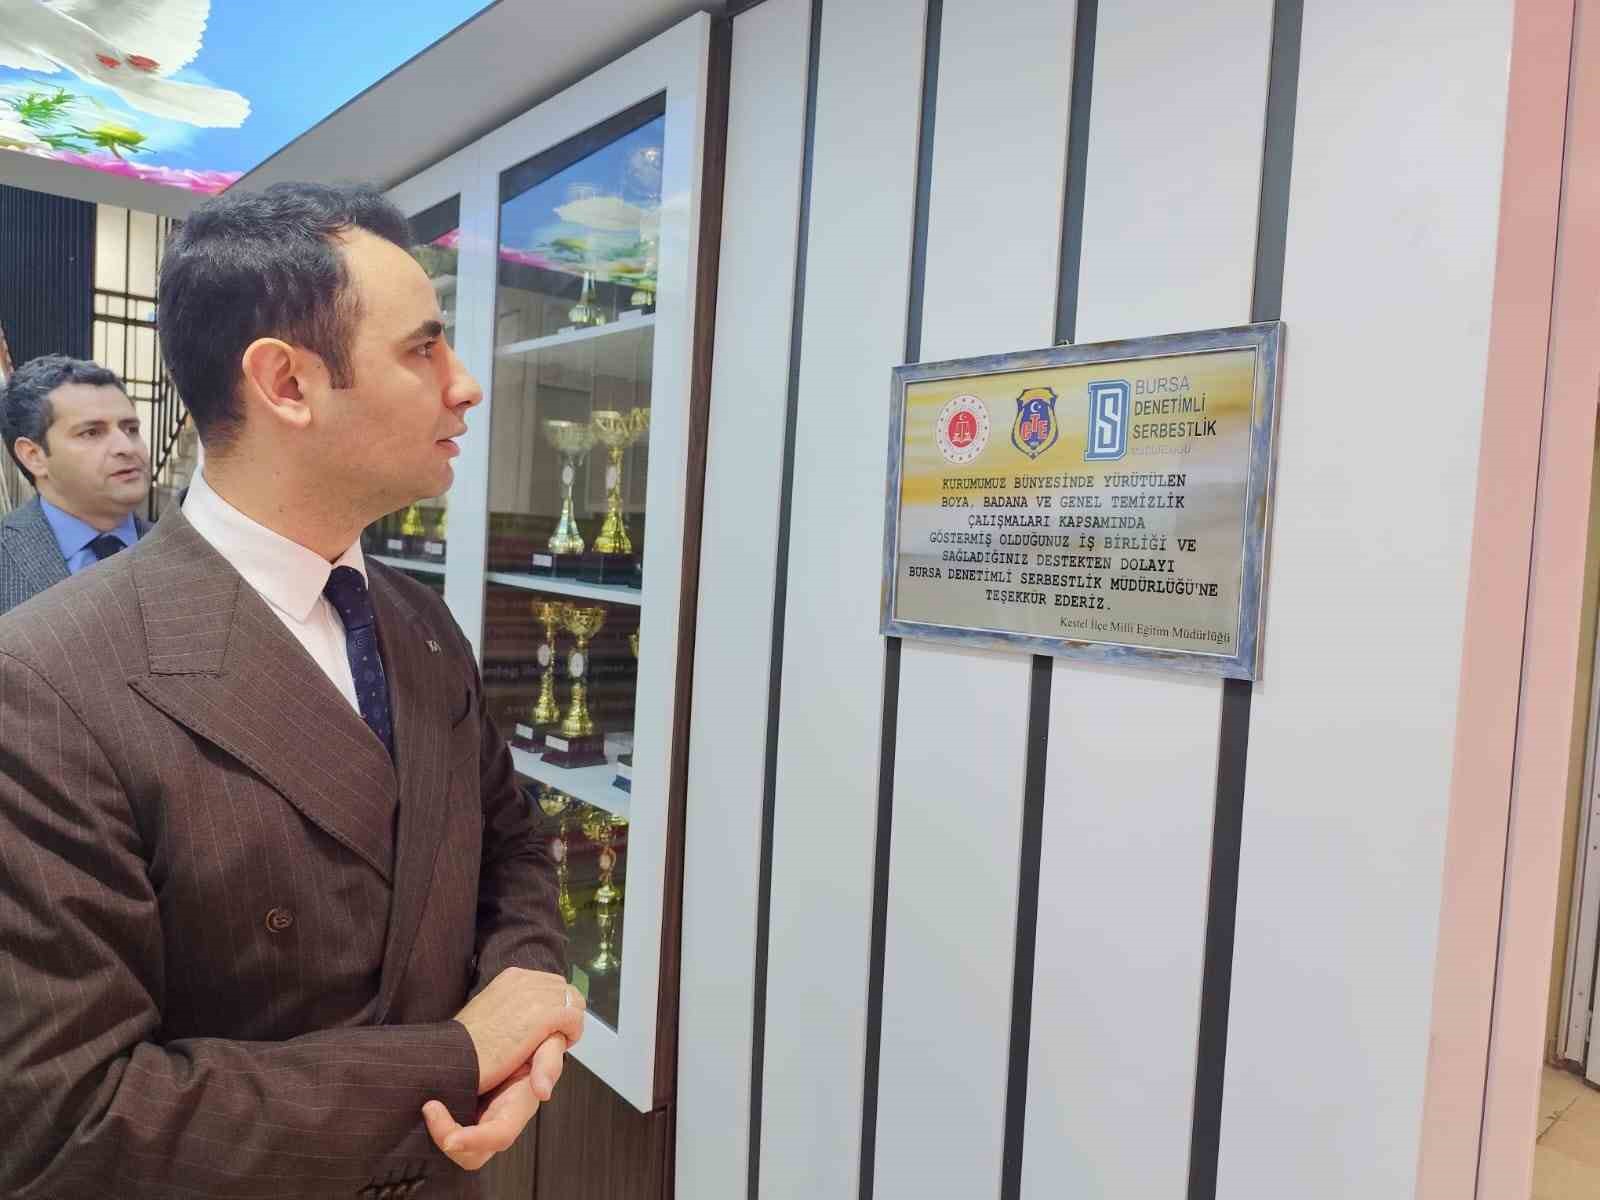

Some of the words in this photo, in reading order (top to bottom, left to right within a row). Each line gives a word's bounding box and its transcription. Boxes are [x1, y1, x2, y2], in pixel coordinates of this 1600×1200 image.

[1135, 376, 1190, 395] BURSA
[1134, 393, 1206, 416] DENETİMLİ
[1132, 418, 1217, 439] SERBESTLİK
[942, 478, 1007, 490] KURUMUMUZ
[1014, 472, 1095, 489] BÜNYESİNDE
[1104, 472, 1187, 488] YÜRÜTÜLEN
[984, 496, 1028, 508] BADANA
[1036, 496, 1052, 508] VE
[1060, 495, 1102, 509] GENEL
[1111, 491, 1185, 509] TEMİZLİK
[968, 514, 1050, 529] ÇALIŞMALARI
[1059, 515, 1146, 529] KAPSAMINDA
[929, 528, 992, 548] GÖSTERMİŞ
[1000, 532, 1070, 547] OLDUĞUNUZ
[1079, 532, 1096, 552] İŞ
[1104, 534, 1168, 551] BİRLİĞİ
[1178, 538, 1197, 551] VE
[942, 549, 1029, 566] SAĞLADIĞINIZ
[1037, 555, 1112, 569] DESTEKTEN
[1121, 558, 1175, 573] DOLAYI
[909, 566, 942, 579] BURSA
[948, 568, 1013, 584] DENETİMLİ
[1020, 572, 1103, 589] SERBESTLİK
[1110, 575, 1218, 597] MÜDÜRLÜĞÜ'NE
[986, 589, 1047, 605] TEŞEKKÜR
[1055, 593, 1112, 611] EDERİZ.
[1060, 616, 1089, 630] Kestel
[1137, 623, 1169, 639] Eğitim
